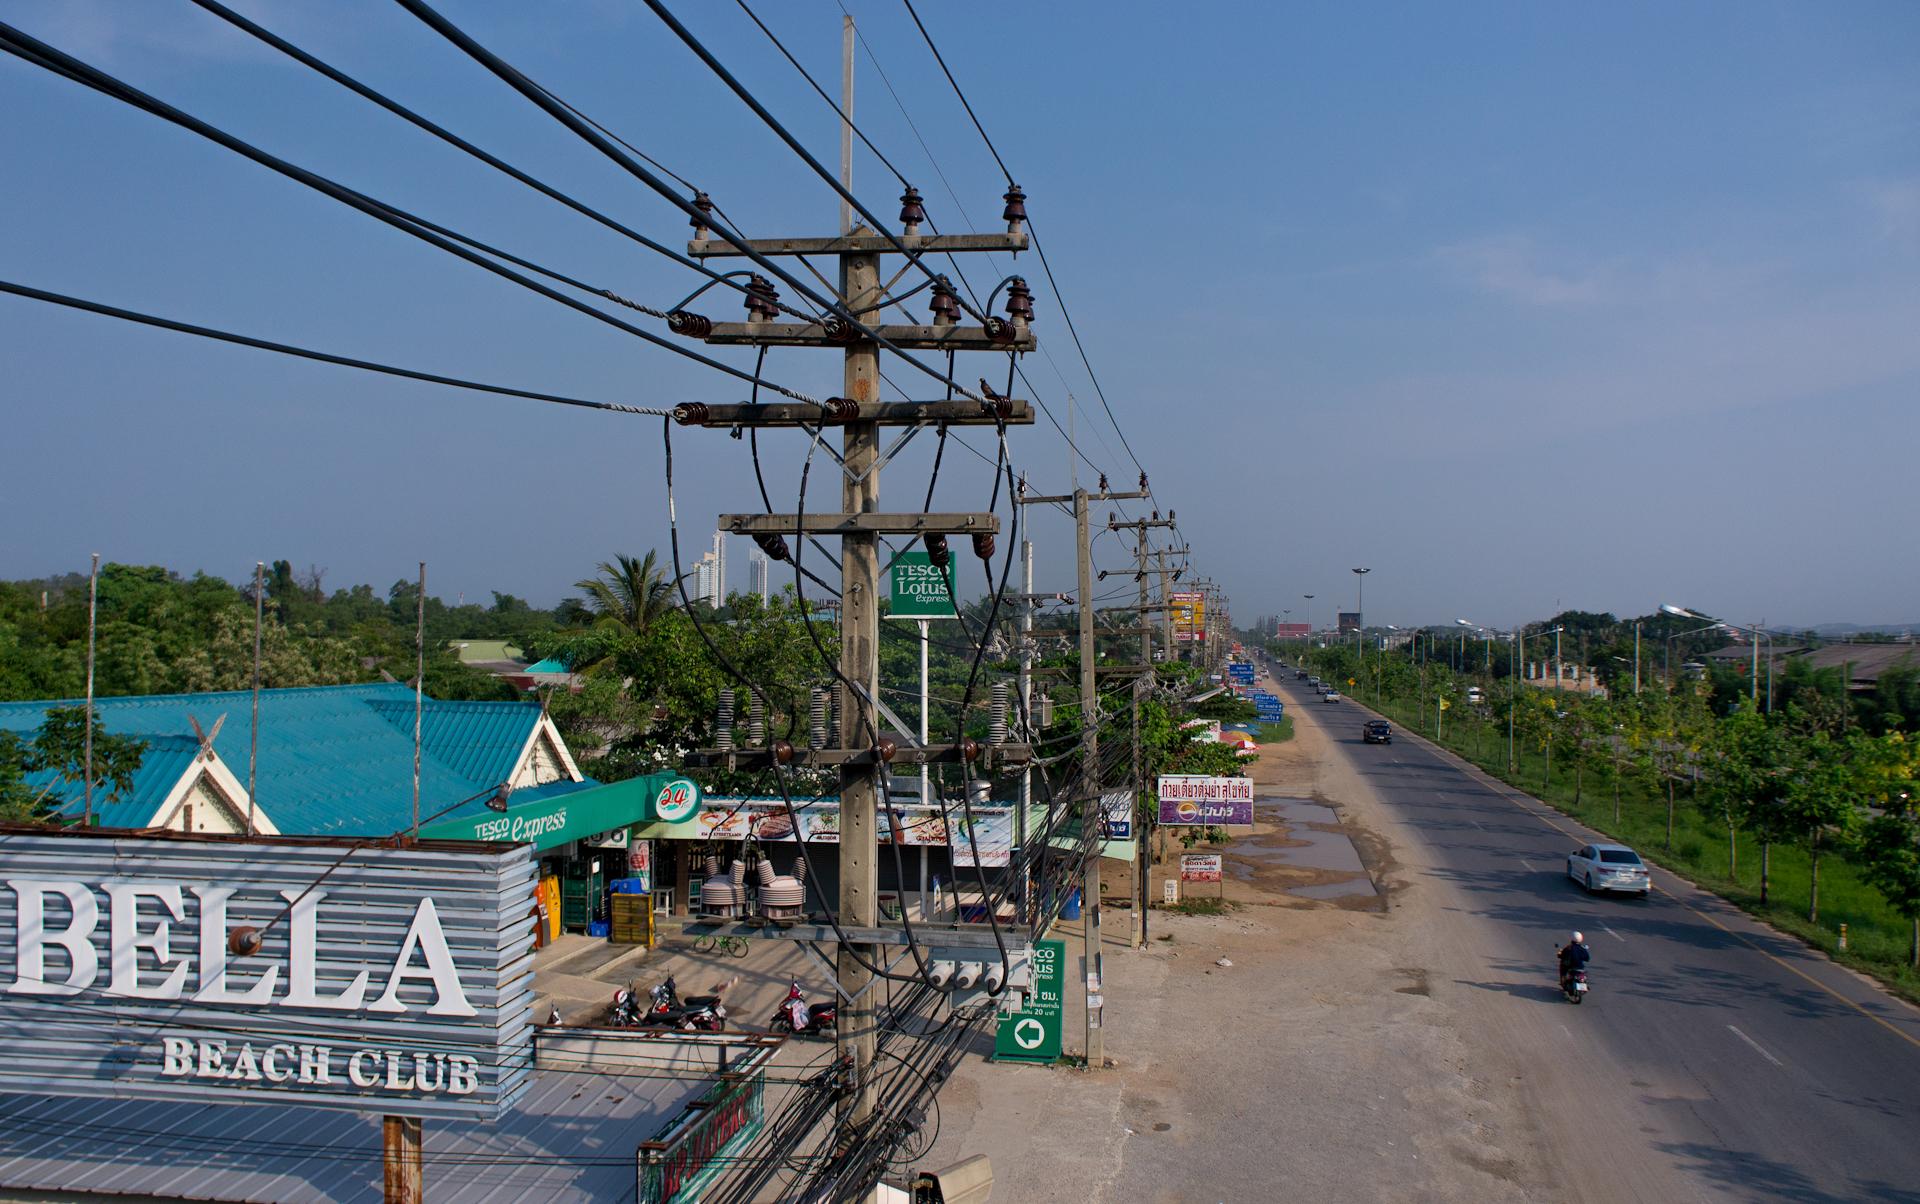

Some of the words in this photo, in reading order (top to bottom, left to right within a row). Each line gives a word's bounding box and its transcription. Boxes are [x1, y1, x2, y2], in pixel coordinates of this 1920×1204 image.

[896, 564, 951, 576] TESCO
[898, 580, 949, 595] Lotus
[915, 594, 950, 604] express
[660, 787, 687, 806] 24
[474, 816, 510, 838] TESCO
[512, 811, 566, 841] express
[7, 879, 478, 1017] BELLA
[162, 1036, 331, 1085] BEACH
[348, 1047, 480, 1095] CLUB
